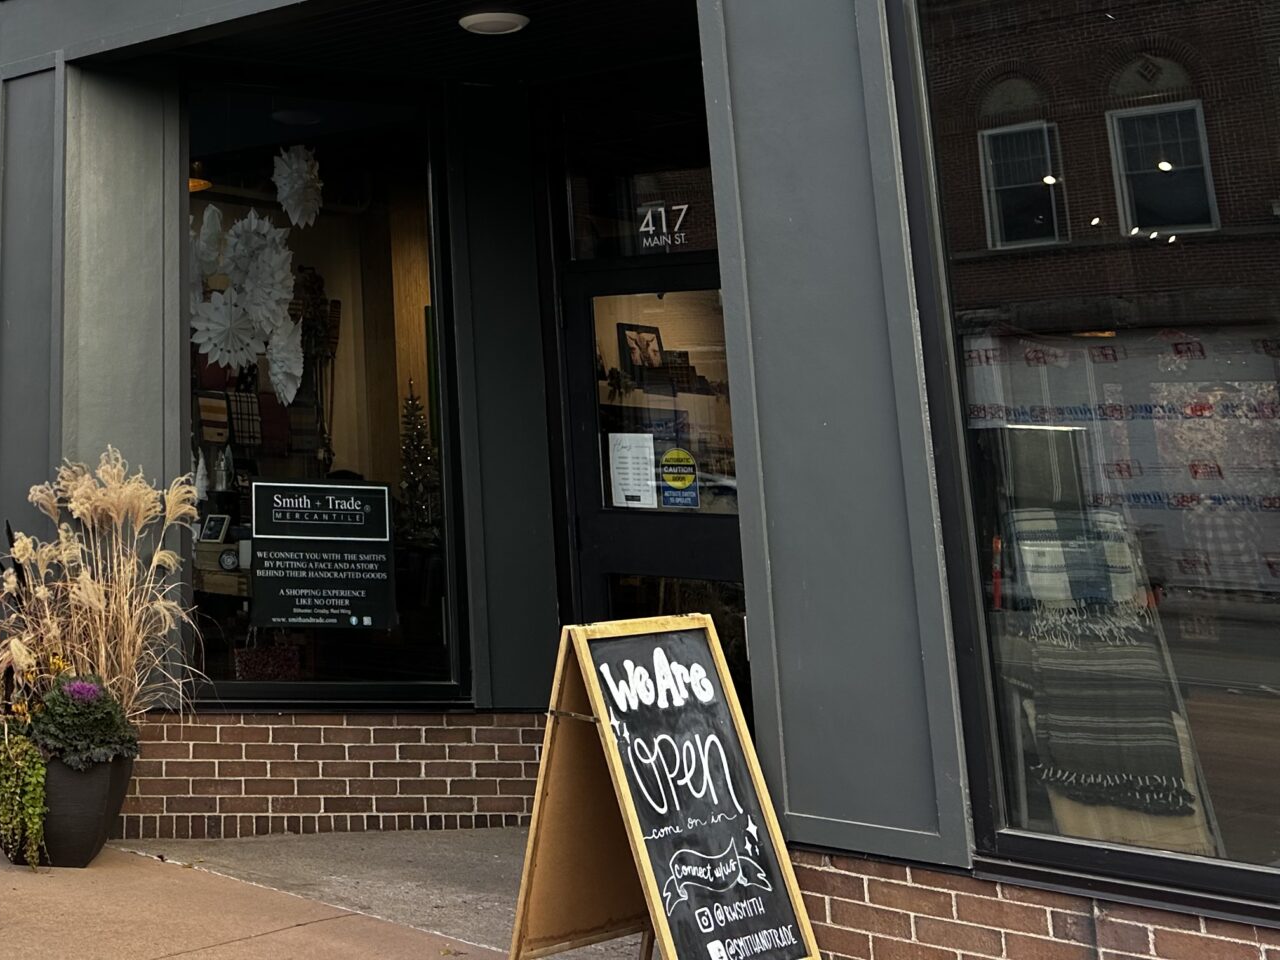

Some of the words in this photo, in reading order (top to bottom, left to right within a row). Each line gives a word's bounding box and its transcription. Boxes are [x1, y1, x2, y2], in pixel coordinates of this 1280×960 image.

[639, 204, 689, 234] 417
[643, 234, 671, 248] MAIN
[273, 494, 311, 508] Smith
[325, 496, 362, 510] Trade
[275, 513, 361, 522] MERCANTILE
[269, 551, 304, 559] CONNECT
[305, 552, 320, 560] YOU
[308, 571, 361, 579] HANDCRAFTED
[599, 659, 656, 713] We
[653, 647, 715, 709] Are
[644, 825, 684, 840] come
[687, 817, 707, 829] on
[711, 812, 737, 824] in
[713, 896, 766, 927] @RWSMITH
[725, 925, 798, 960] @SMITHANDTRADE
